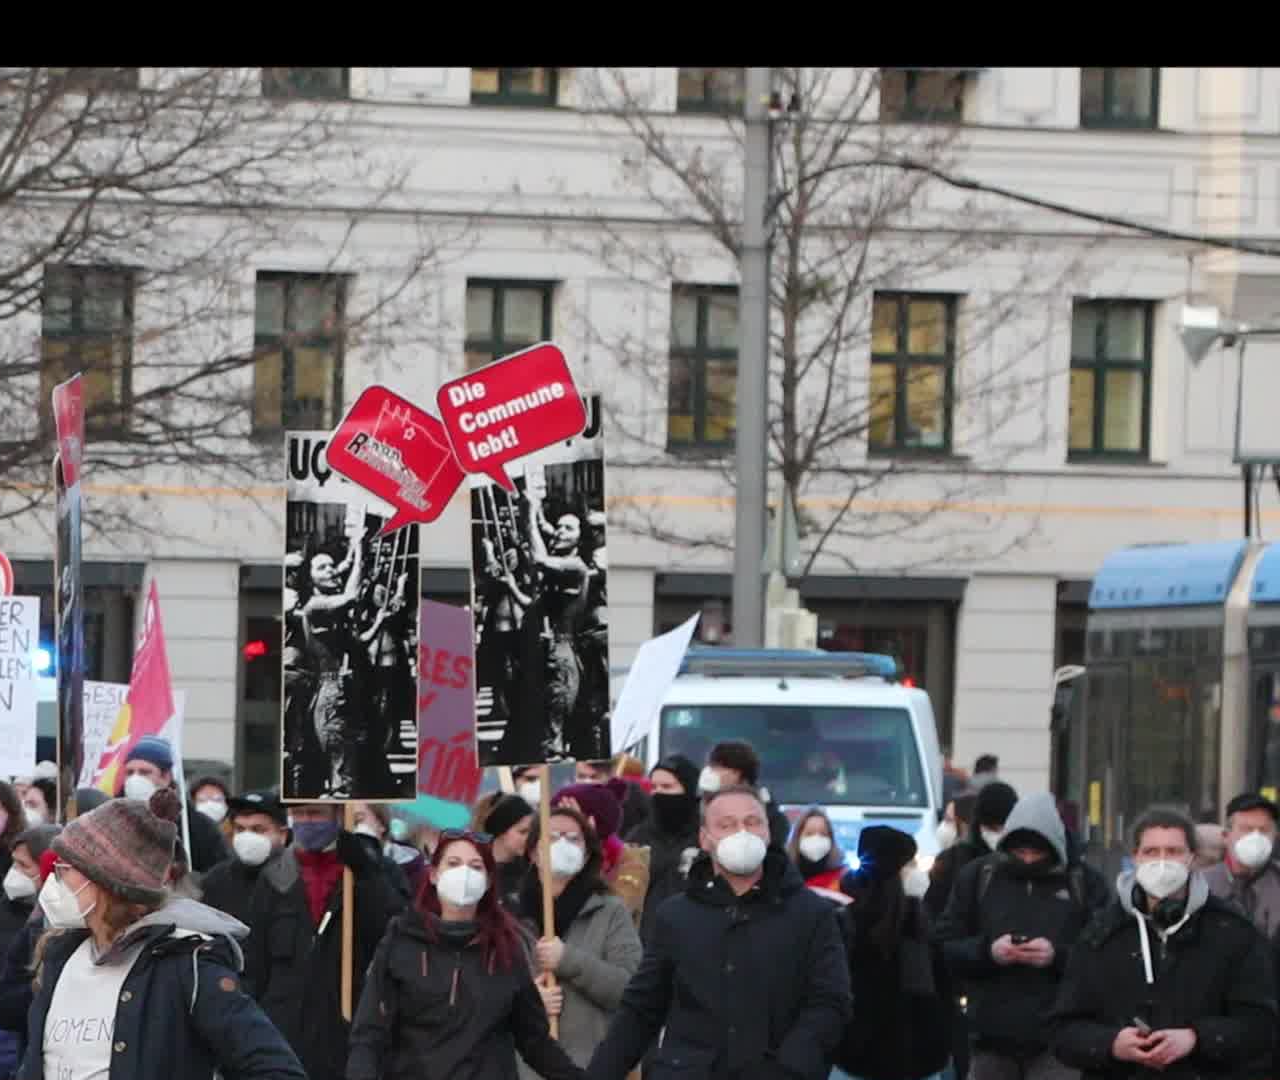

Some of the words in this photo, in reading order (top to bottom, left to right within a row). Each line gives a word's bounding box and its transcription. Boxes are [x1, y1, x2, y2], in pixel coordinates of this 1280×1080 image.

[448, 381, 486, 408] Die
[459, 382, 565, 433] Commune
[468, 425, 520, 461] lebt!
